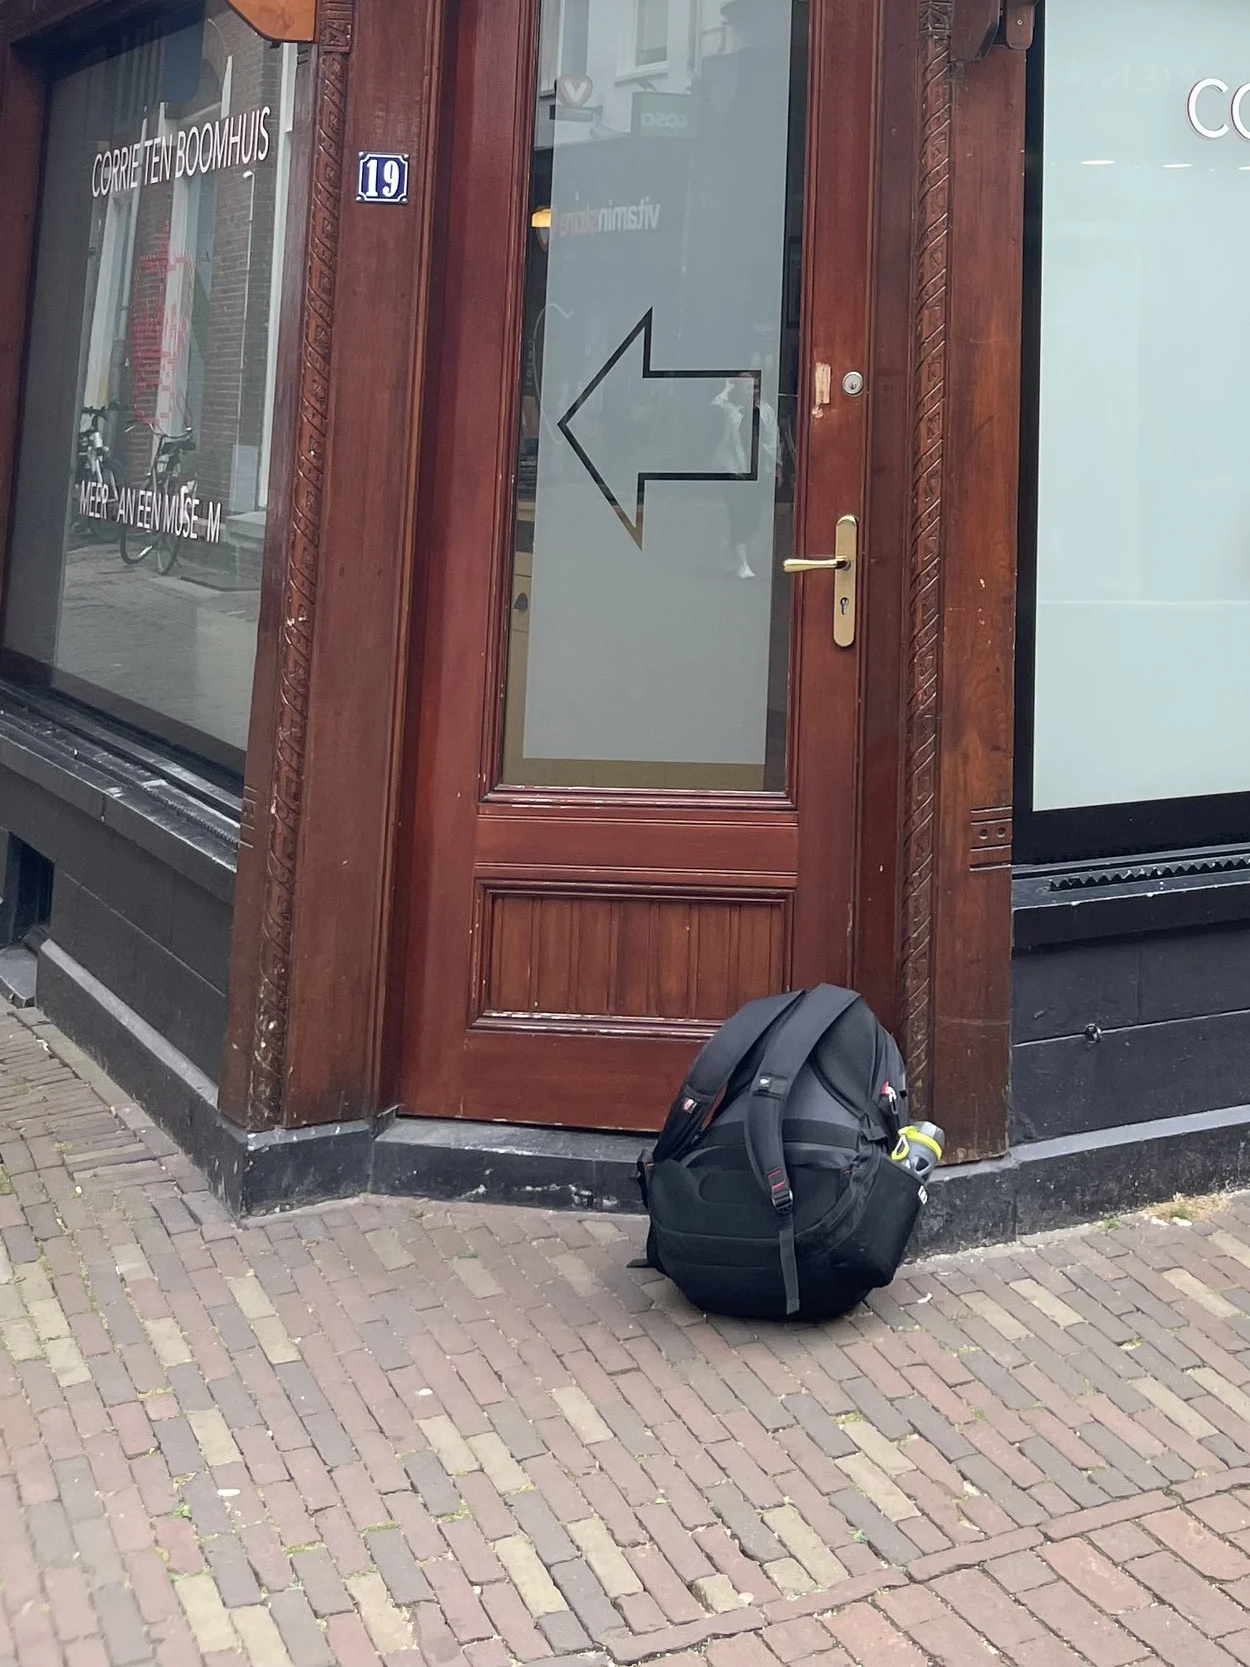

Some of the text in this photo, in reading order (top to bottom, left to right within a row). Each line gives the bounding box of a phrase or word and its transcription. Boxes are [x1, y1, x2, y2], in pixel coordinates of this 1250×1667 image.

[92, 105, 271, 198] CORRIE TEN BOOMHUIS
[365, 159, 400, 198] 19
[79, 479, 109, 520] MEER
[136, 489, 162, 532] EEN
[162, 493, 222, 544] MUSEM
